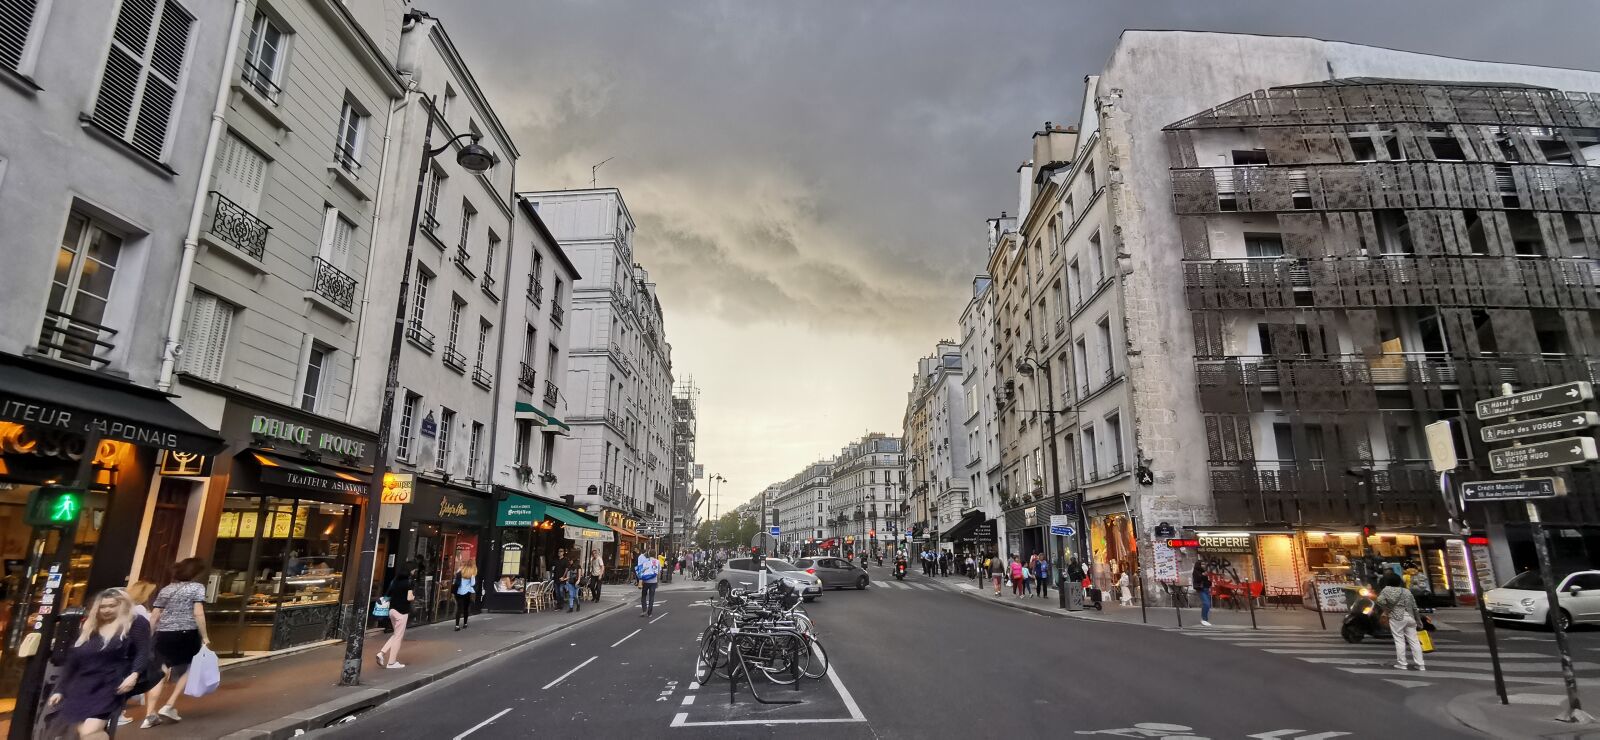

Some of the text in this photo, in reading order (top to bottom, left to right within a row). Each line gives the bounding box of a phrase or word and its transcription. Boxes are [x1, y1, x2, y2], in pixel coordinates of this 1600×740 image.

[1521, 393, 1543, 403] SULLY
[2, 400, 73, 428] ITEUR
[1496, 428, 1515, 436] Place
[1532, 420, 1562, 431] VOSGES
[251, 414, 366, 458] DELICE HOUSE
[1505, 451, 1549, 463] VICTOR HUGO
[287, 472, 328, 488] TRAITEUR
[1495, 482, 1525, 490] Municipal
[1198, 537, 1250, 547] CREPERIE
